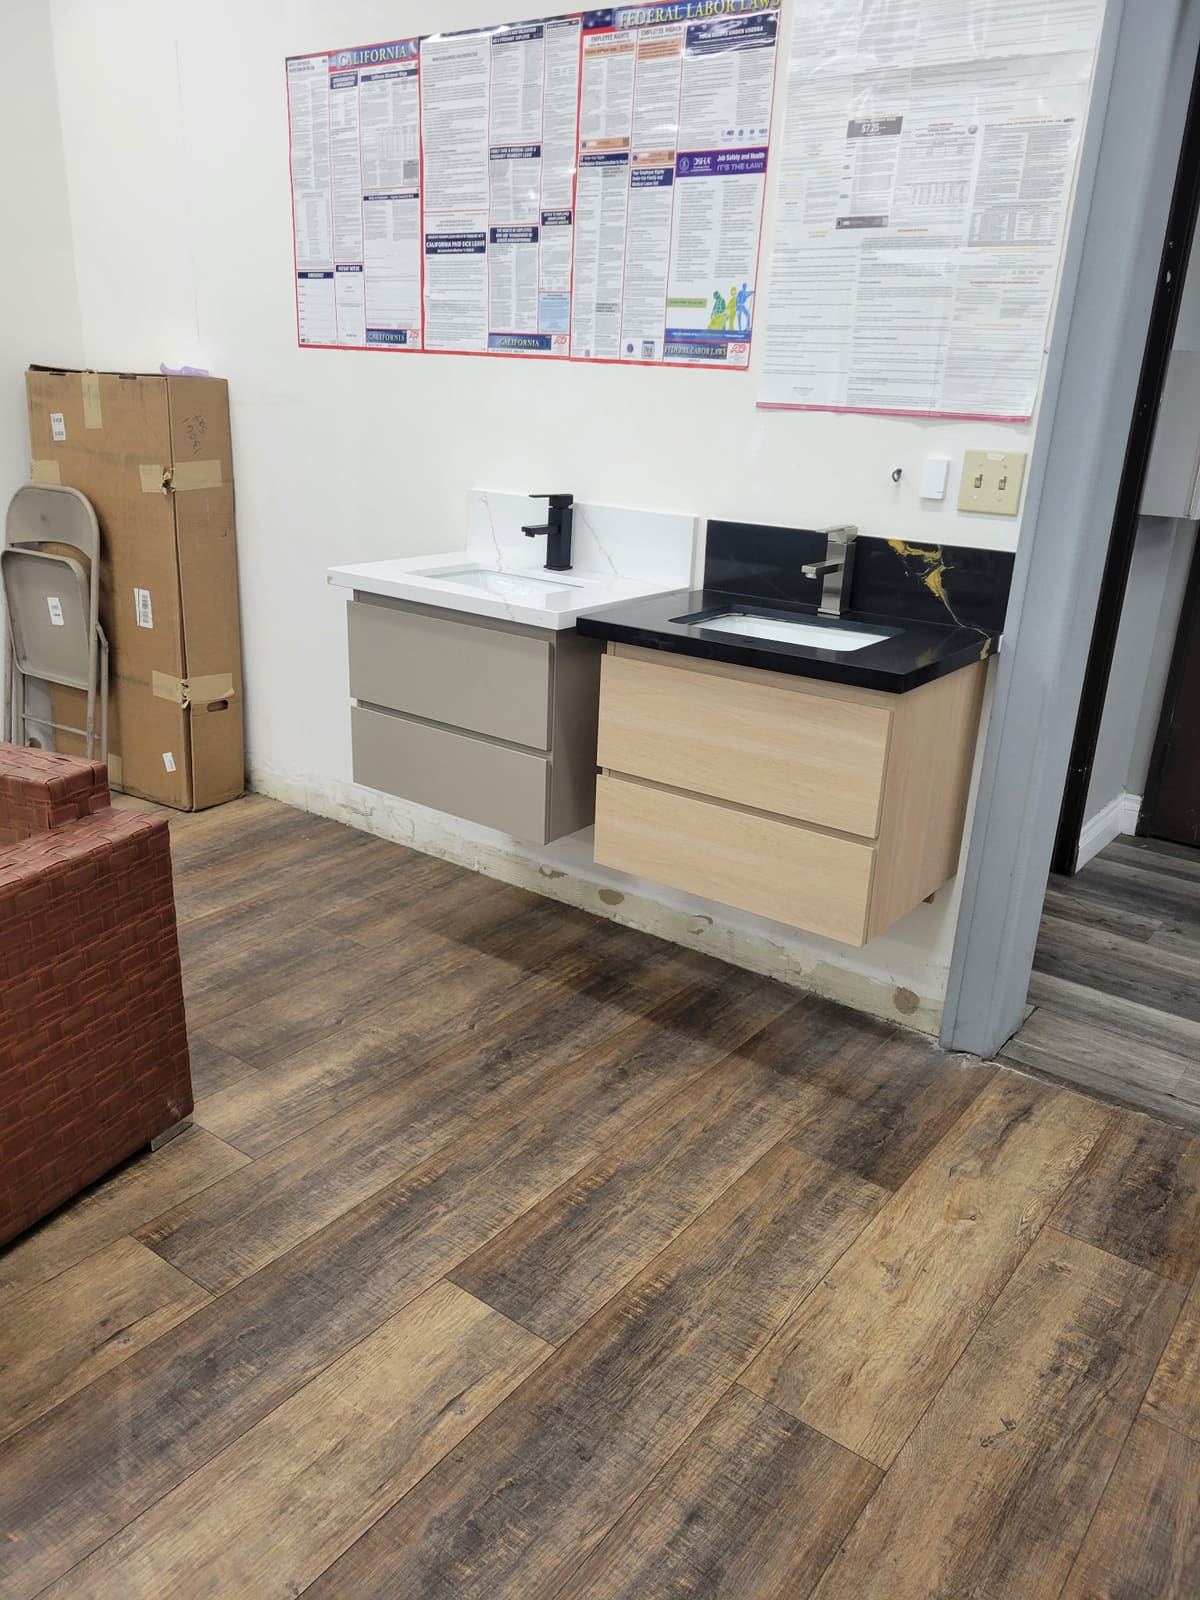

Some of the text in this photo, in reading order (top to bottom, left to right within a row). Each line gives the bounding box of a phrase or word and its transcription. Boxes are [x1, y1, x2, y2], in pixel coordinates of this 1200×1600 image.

[620, 7, 682, 27] FEDERAL
[687, 0, 736, 18] LABOR
[339, 46, 407, 68] CALIFORNIA
[717, 154, 726, 162] Job
[726, 153, 741, 161] Safety
[741, 152, 750, 160] and
[731, 163, 745, 171] THE
